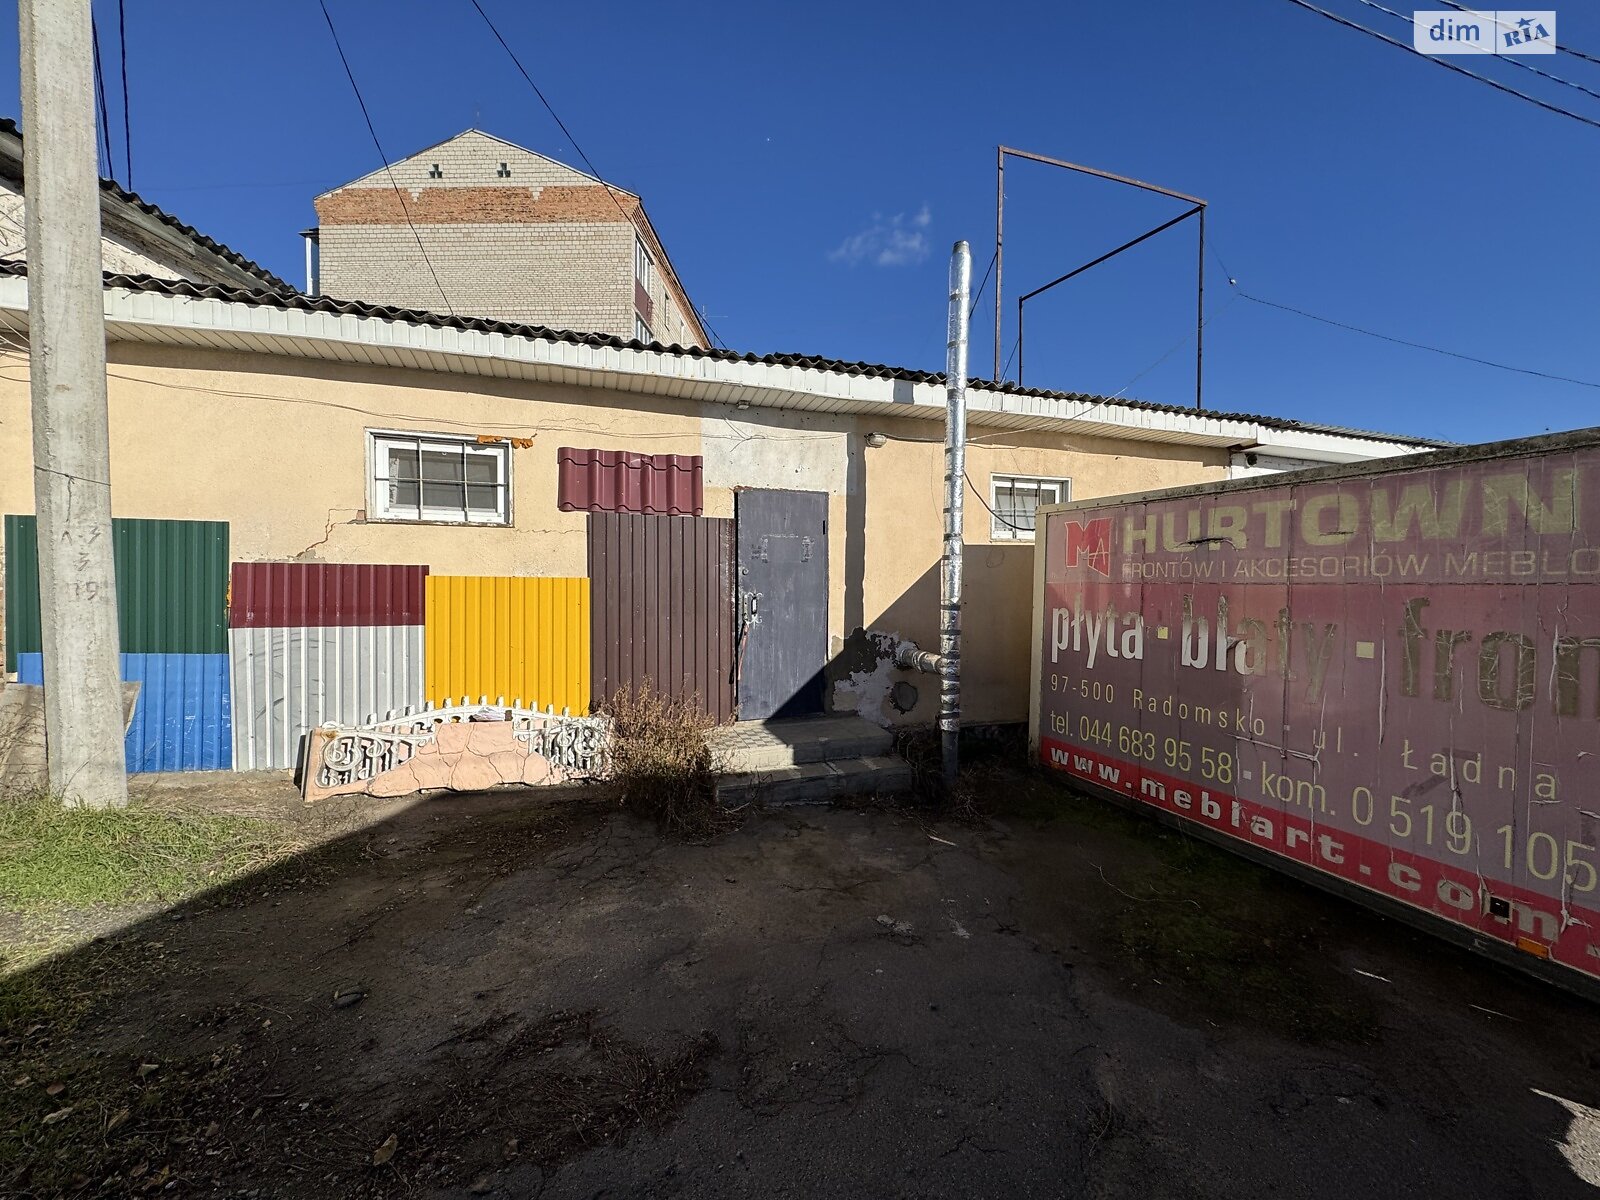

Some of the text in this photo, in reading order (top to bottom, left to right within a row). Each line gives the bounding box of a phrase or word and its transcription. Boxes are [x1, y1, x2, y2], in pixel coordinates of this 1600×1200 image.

[1122, 468, 1585, 554] HURTOWN
[1122, 557, 1213, 578] FRONTÓW
[1233, 548, 1429, 578] AKCESORIÓW
[1444, 548, 1600, 577] MEBLO
[1051, 592, 1144, 669] płyta
[1051, 674, 1556, 800] 97-500 Radomsko ul. Ładna
[1050, 710, 1597, 892] tel. 044 683 95 58 kom. 0 519 105
